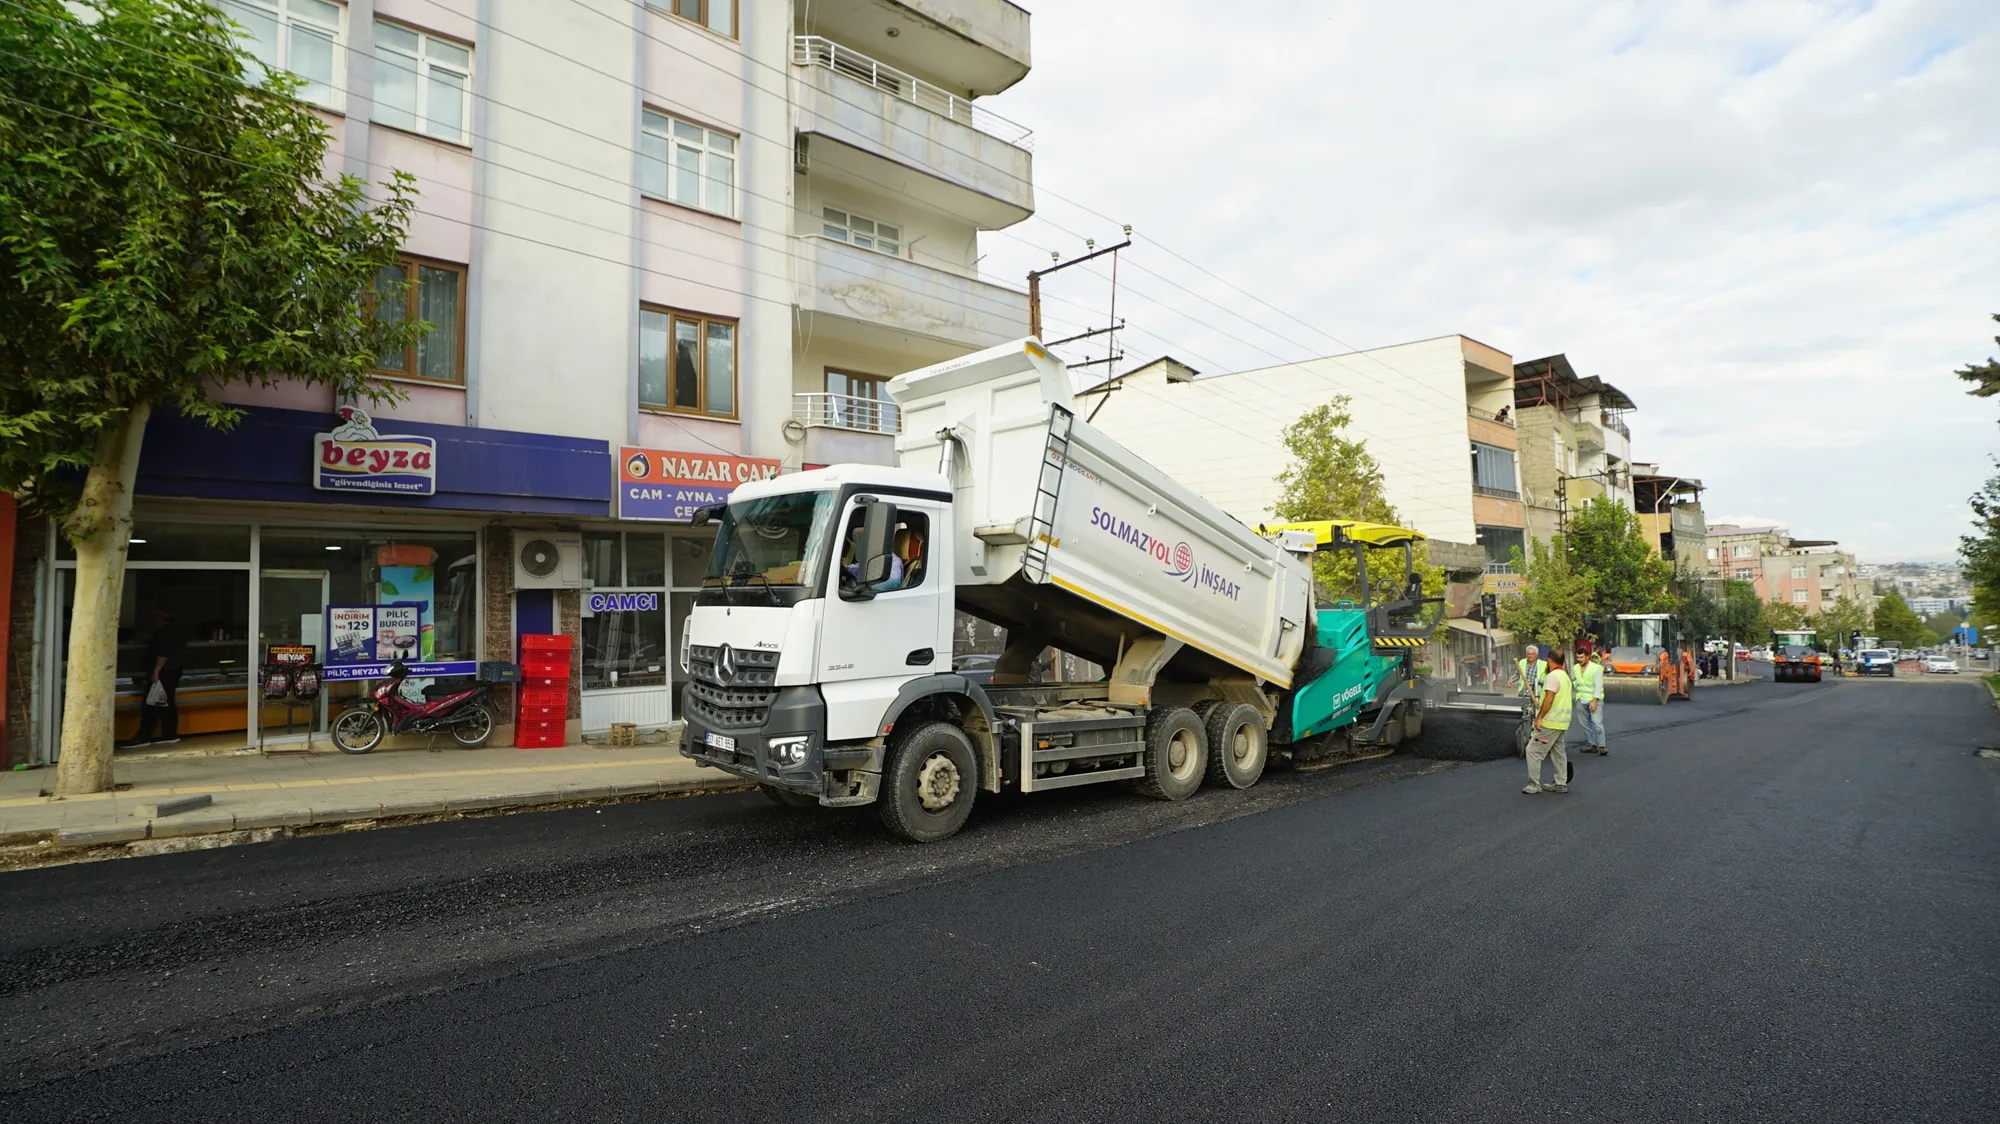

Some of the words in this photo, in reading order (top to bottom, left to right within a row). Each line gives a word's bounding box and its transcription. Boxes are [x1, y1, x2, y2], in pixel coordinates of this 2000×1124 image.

[322, 440, 431, 473] beyza
[660, 456, 732, 482] NAZAR
[736, 462, 776, 483] CAM
[629, 488, 663, 500] CAM
[675, 490, 715, 503] AYNA
[1090, 506, 1171, 566] SOLMAZYOL
[1200, 563, 1241, 602] İNŞAAT
[1496, 579, 1517, 590] KAAN
[589, 593, 658, 612] CAMCI
[386, 609, 409, 619] PİLİÇ
[347, 620, 369, 630] 129
[379, 620, 416, 628] BURGER
[277, 653, 306, 661] BEYAK
[327, 668, 351, 677] PİLİÇ,
[352, 668, 379, 676] BEYZA
[1341, 682, 1362, 702] VÖGELE
